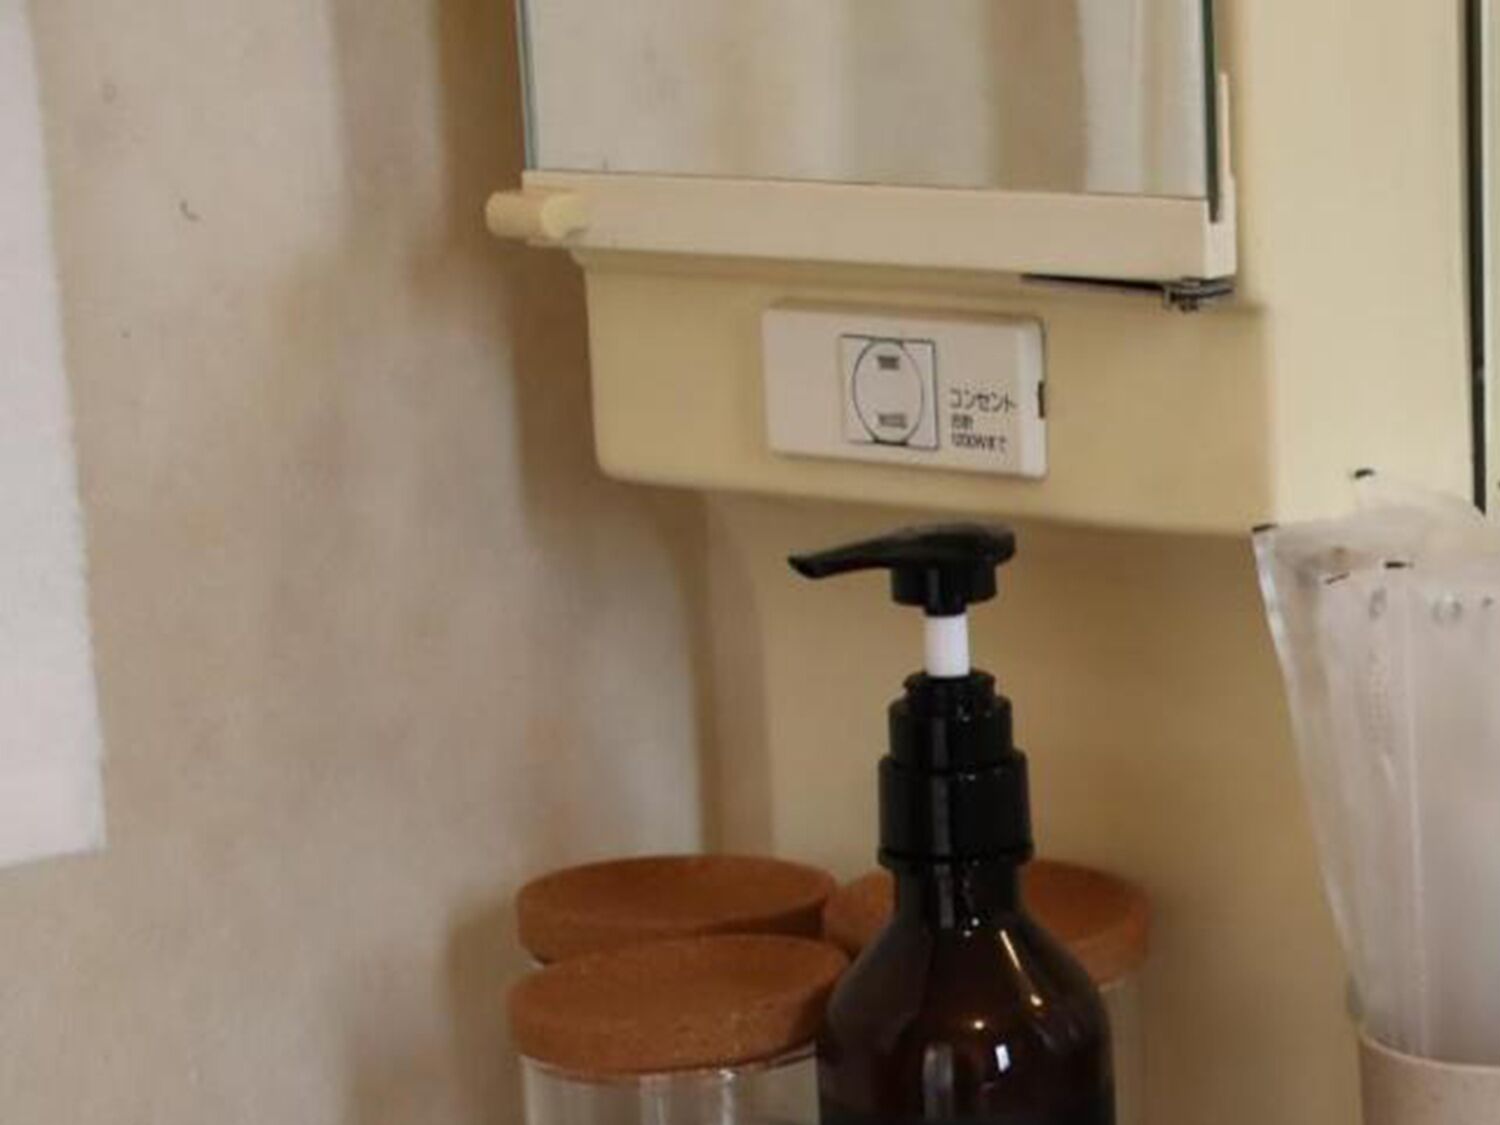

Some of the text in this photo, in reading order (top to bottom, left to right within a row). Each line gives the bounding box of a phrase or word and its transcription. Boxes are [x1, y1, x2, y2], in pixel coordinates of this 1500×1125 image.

[949, 387, 1017, 413] コンセント
